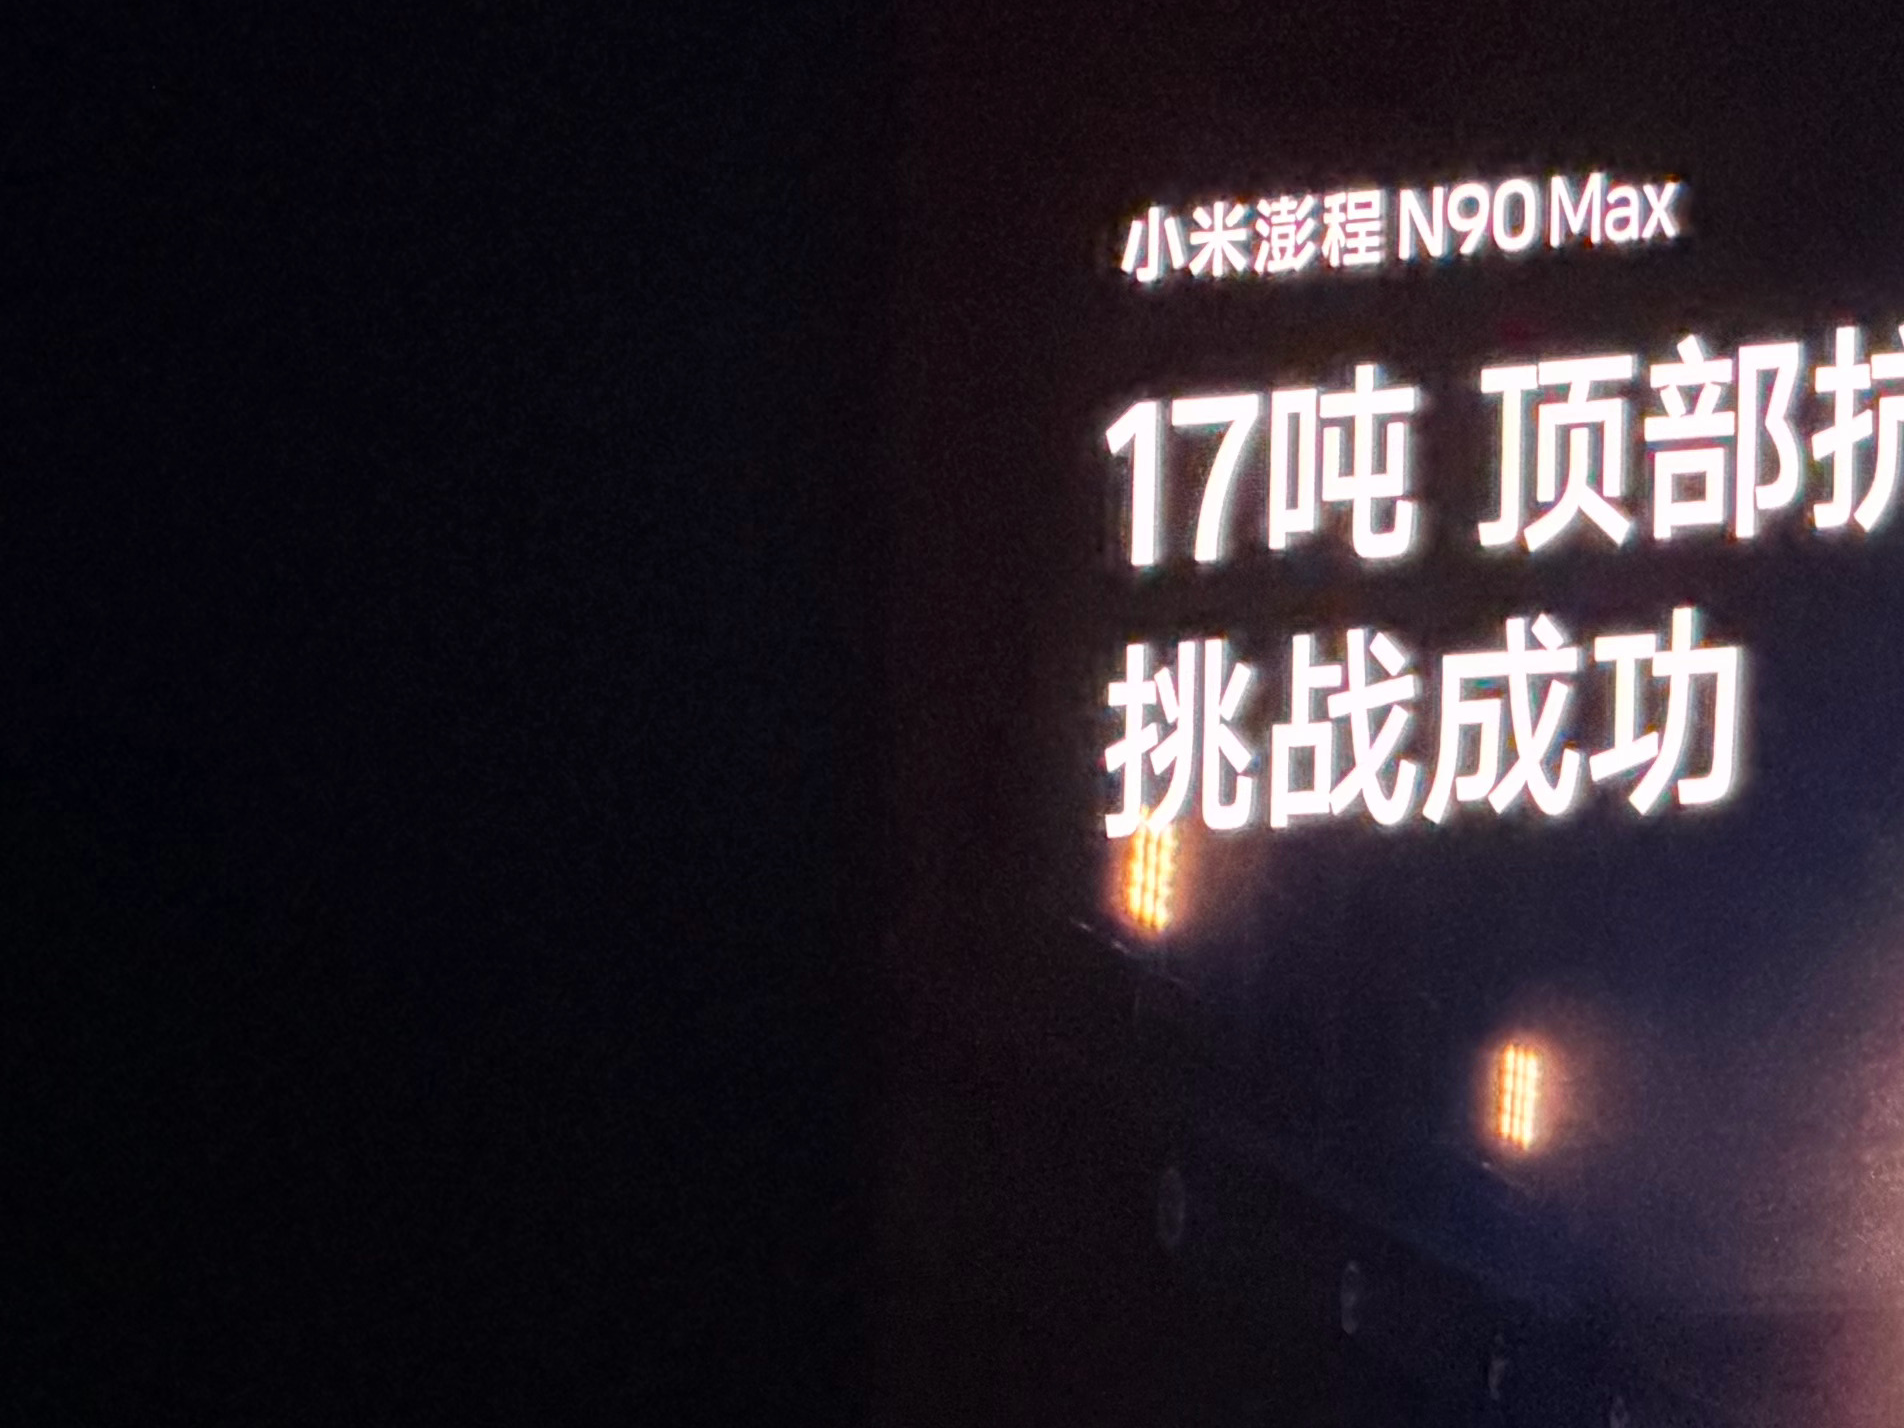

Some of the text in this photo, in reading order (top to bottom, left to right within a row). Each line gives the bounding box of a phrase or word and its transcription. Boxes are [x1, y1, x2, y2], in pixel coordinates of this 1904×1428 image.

[1120, 172, 1678, 283] 小米澎程 N90 Max
[1105, 364, 1419, 566] 17吨
[1105, 607, 1741, 838] 挑战成功
